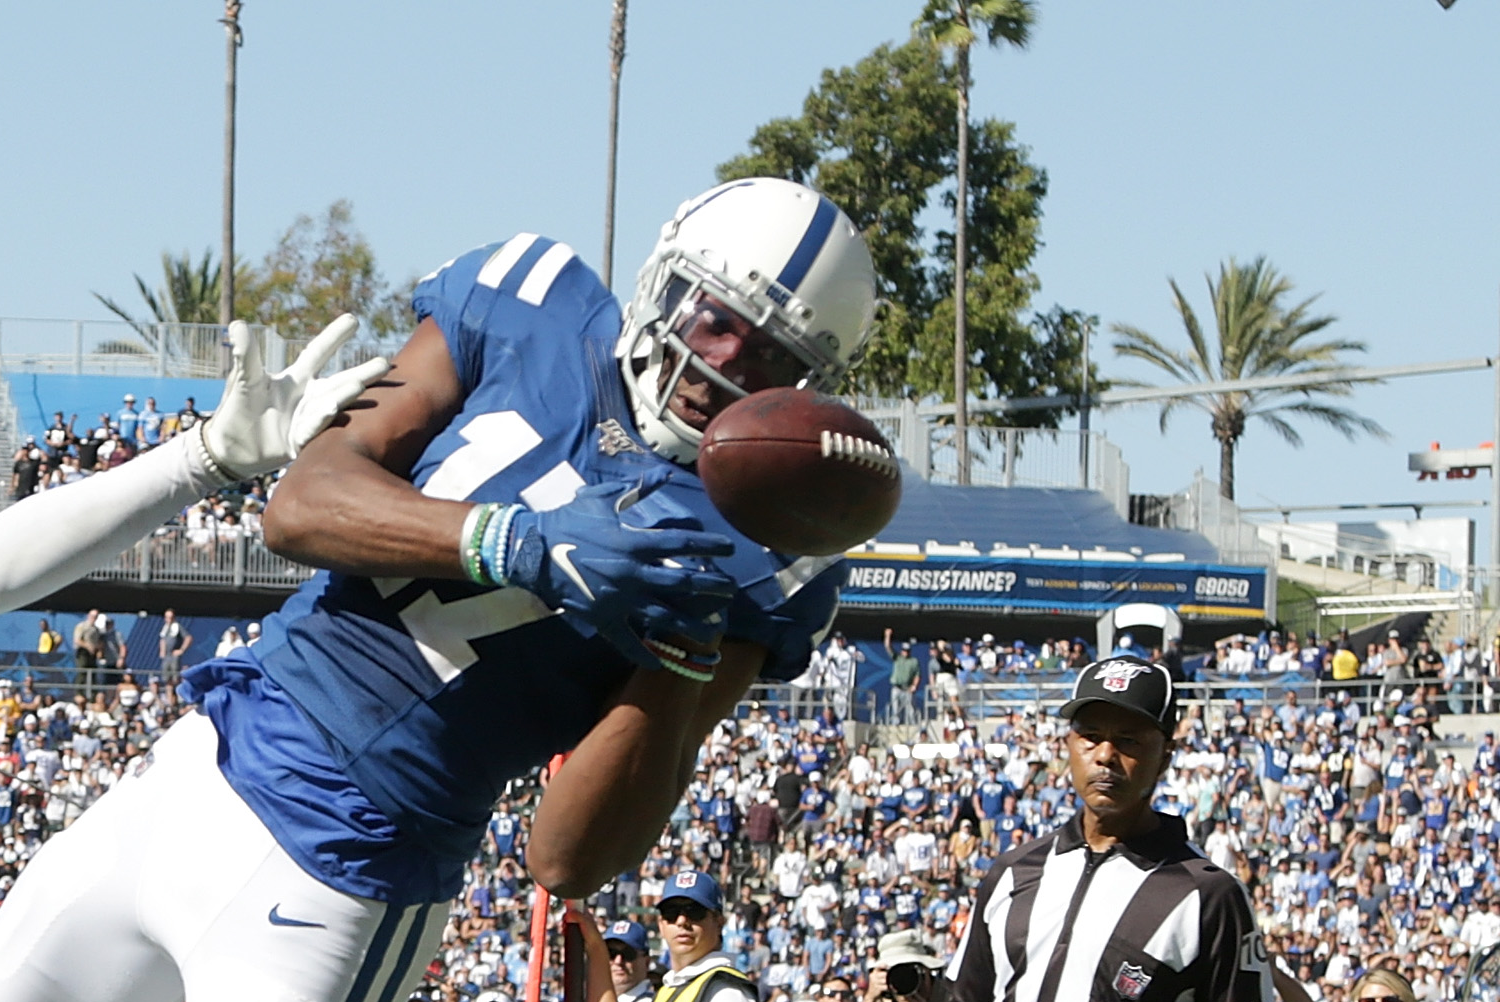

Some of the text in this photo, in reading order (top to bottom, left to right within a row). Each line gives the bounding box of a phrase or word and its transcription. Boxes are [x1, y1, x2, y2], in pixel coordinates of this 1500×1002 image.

[848, 567, 1017, 592] NEED ASSISTANCE?
[1195, 577, 1250, 598] 69050
